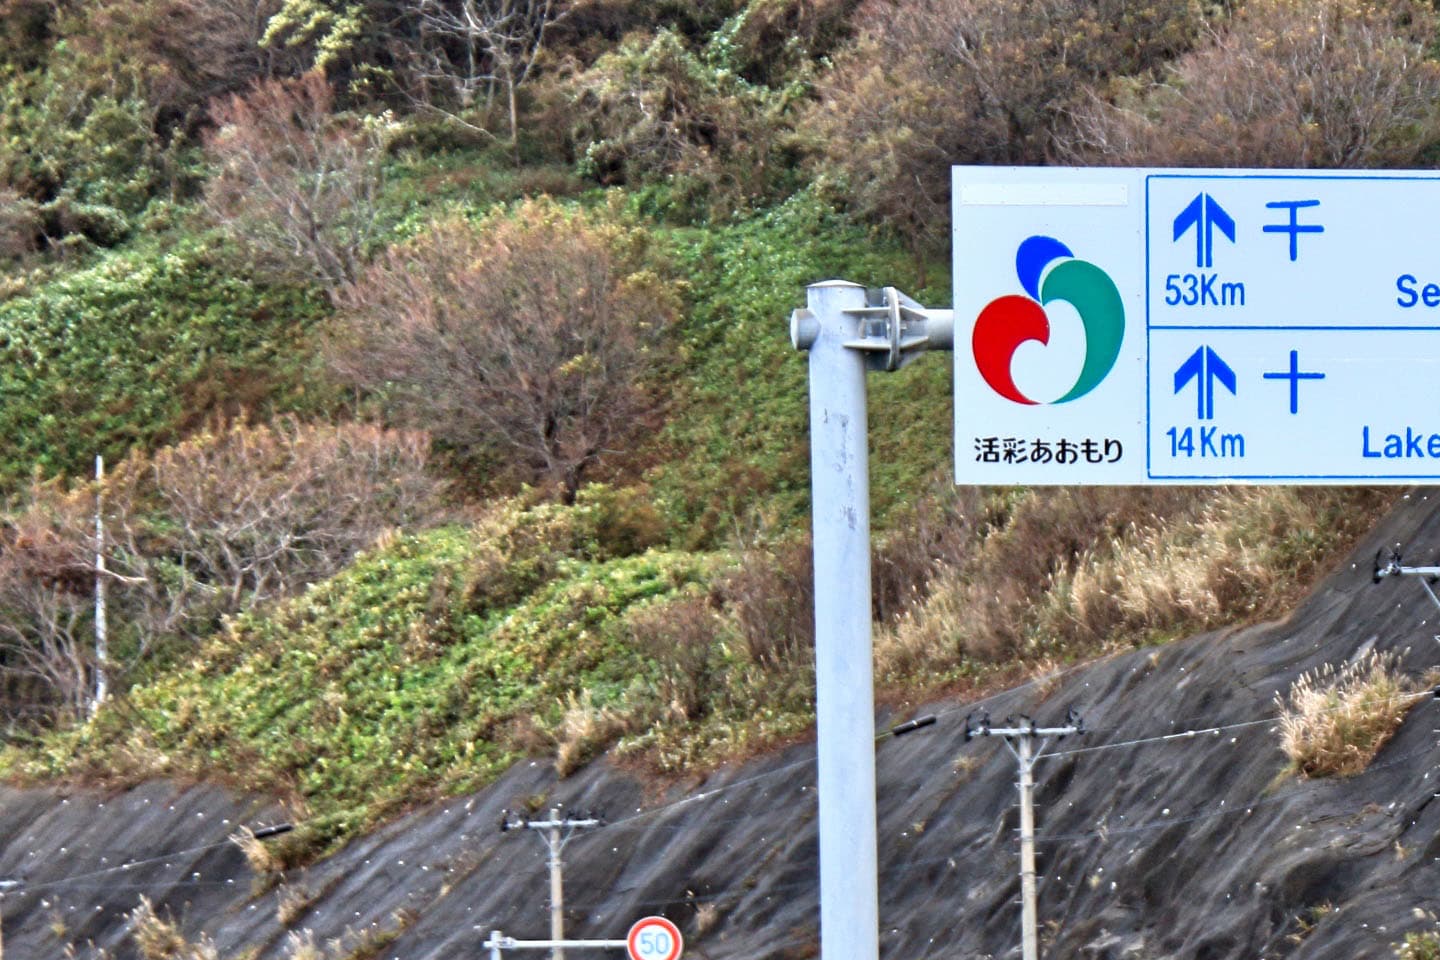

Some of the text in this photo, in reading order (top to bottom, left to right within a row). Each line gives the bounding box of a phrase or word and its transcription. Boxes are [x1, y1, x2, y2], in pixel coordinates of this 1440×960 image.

[1165, 274, 1246, 307] 53Km
[974, 436, 1123, 464] 活彩あおもり
[641, 932, 669, 954] 50
